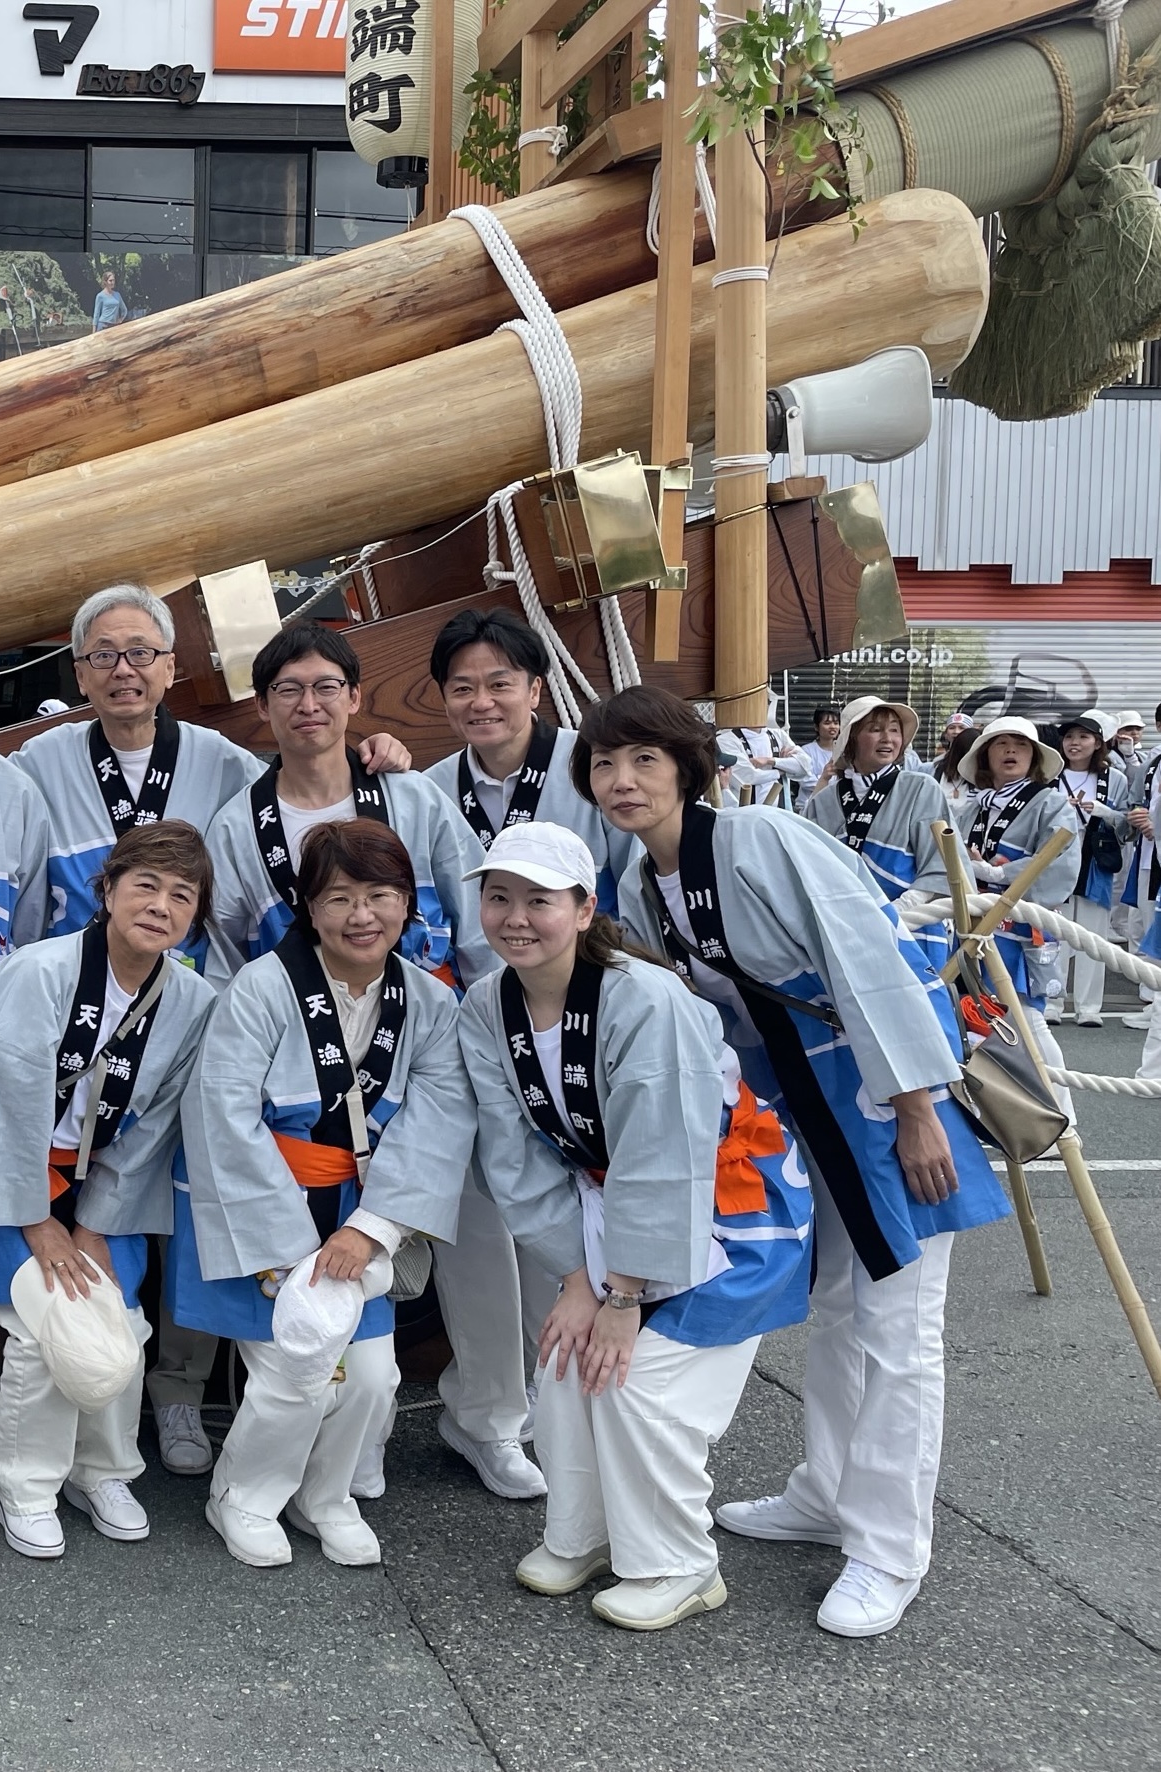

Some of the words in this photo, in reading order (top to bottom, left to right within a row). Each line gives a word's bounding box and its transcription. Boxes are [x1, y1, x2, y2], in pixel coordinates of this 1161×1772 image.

[83, 64, 129, 93] Est
[134, 64, 205, 106] 1865
[97, 756, 136, 821] 天漁
[357, 787, 380, 806] 川
[687, 888, 727, 959] 川端
[356, 983, 404, 1093] 川端町
[563, 1010, 595, 1135] 川端町
